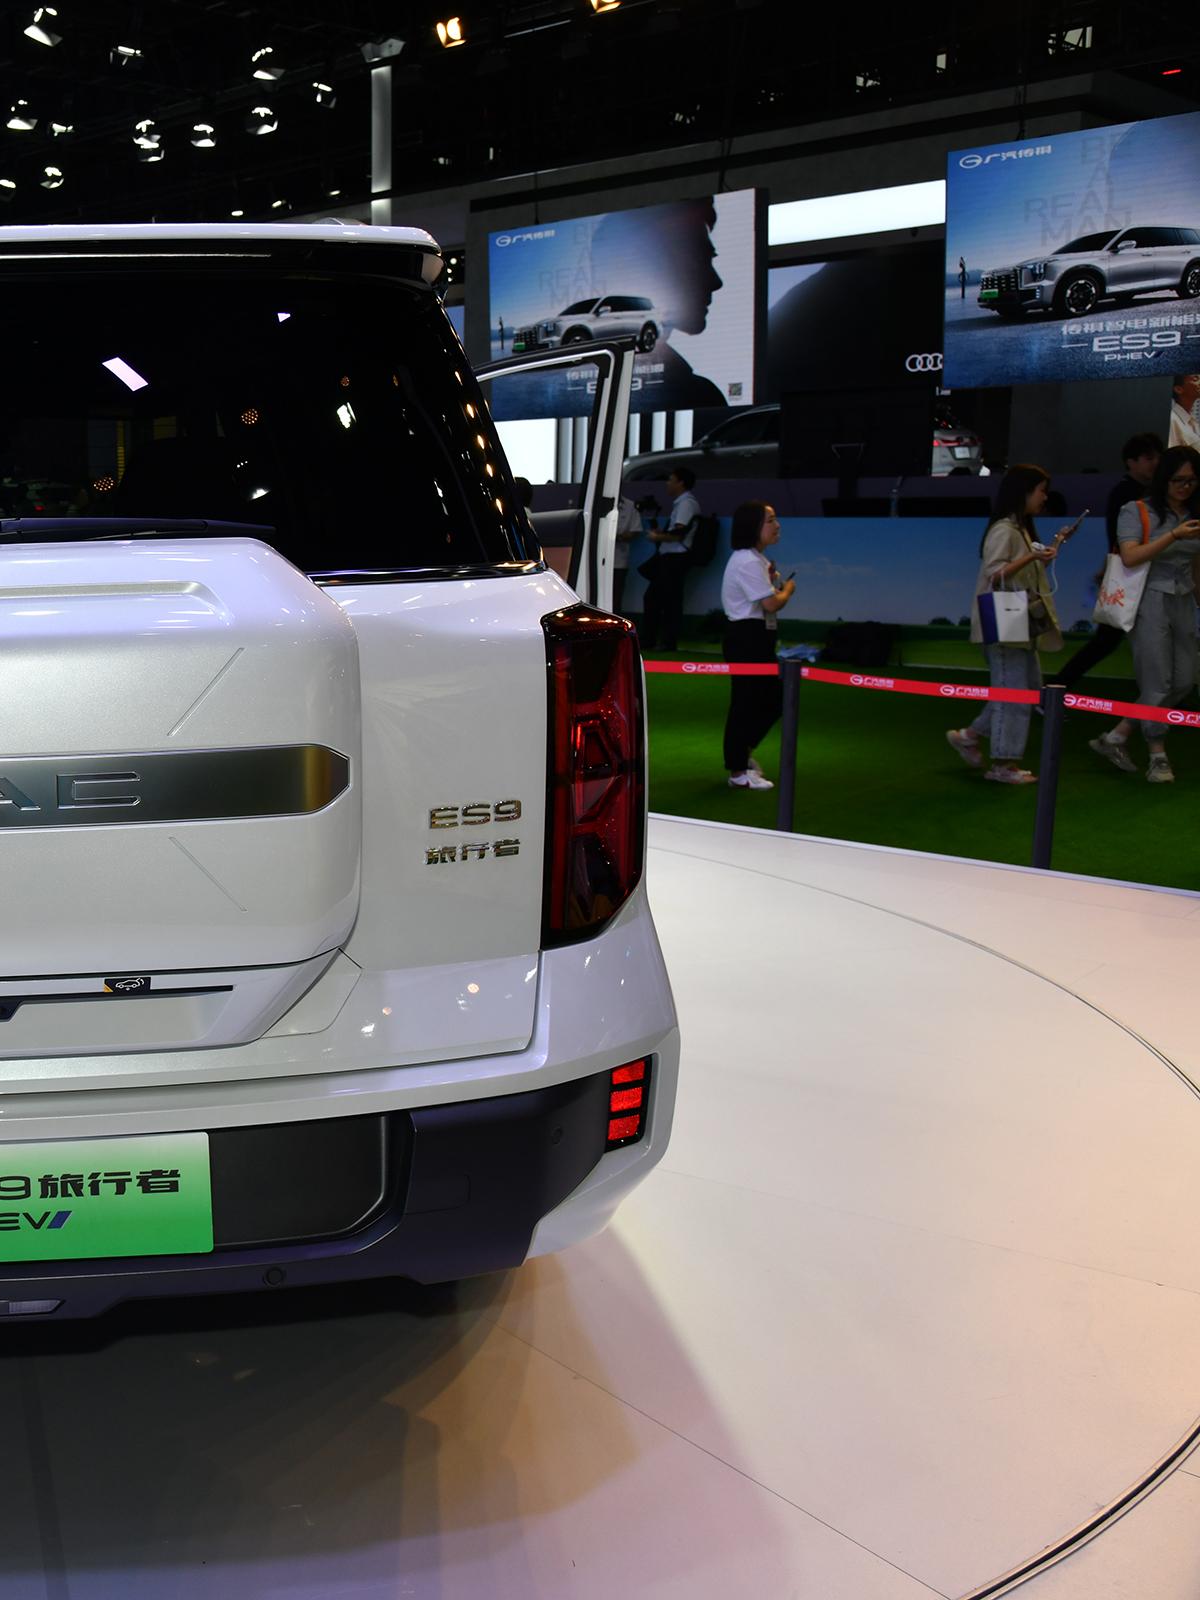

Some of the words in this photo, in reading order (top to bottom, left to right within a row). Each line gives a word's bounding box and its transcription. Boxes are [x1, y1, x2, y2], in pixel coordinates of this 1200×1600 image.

[1092, 330, 1181, 352] ES9
[1104, 350, 1156, 362] PHEV
[429, 799, 522, 829] ES9
[425, 838, 521, 865] 旅行者
